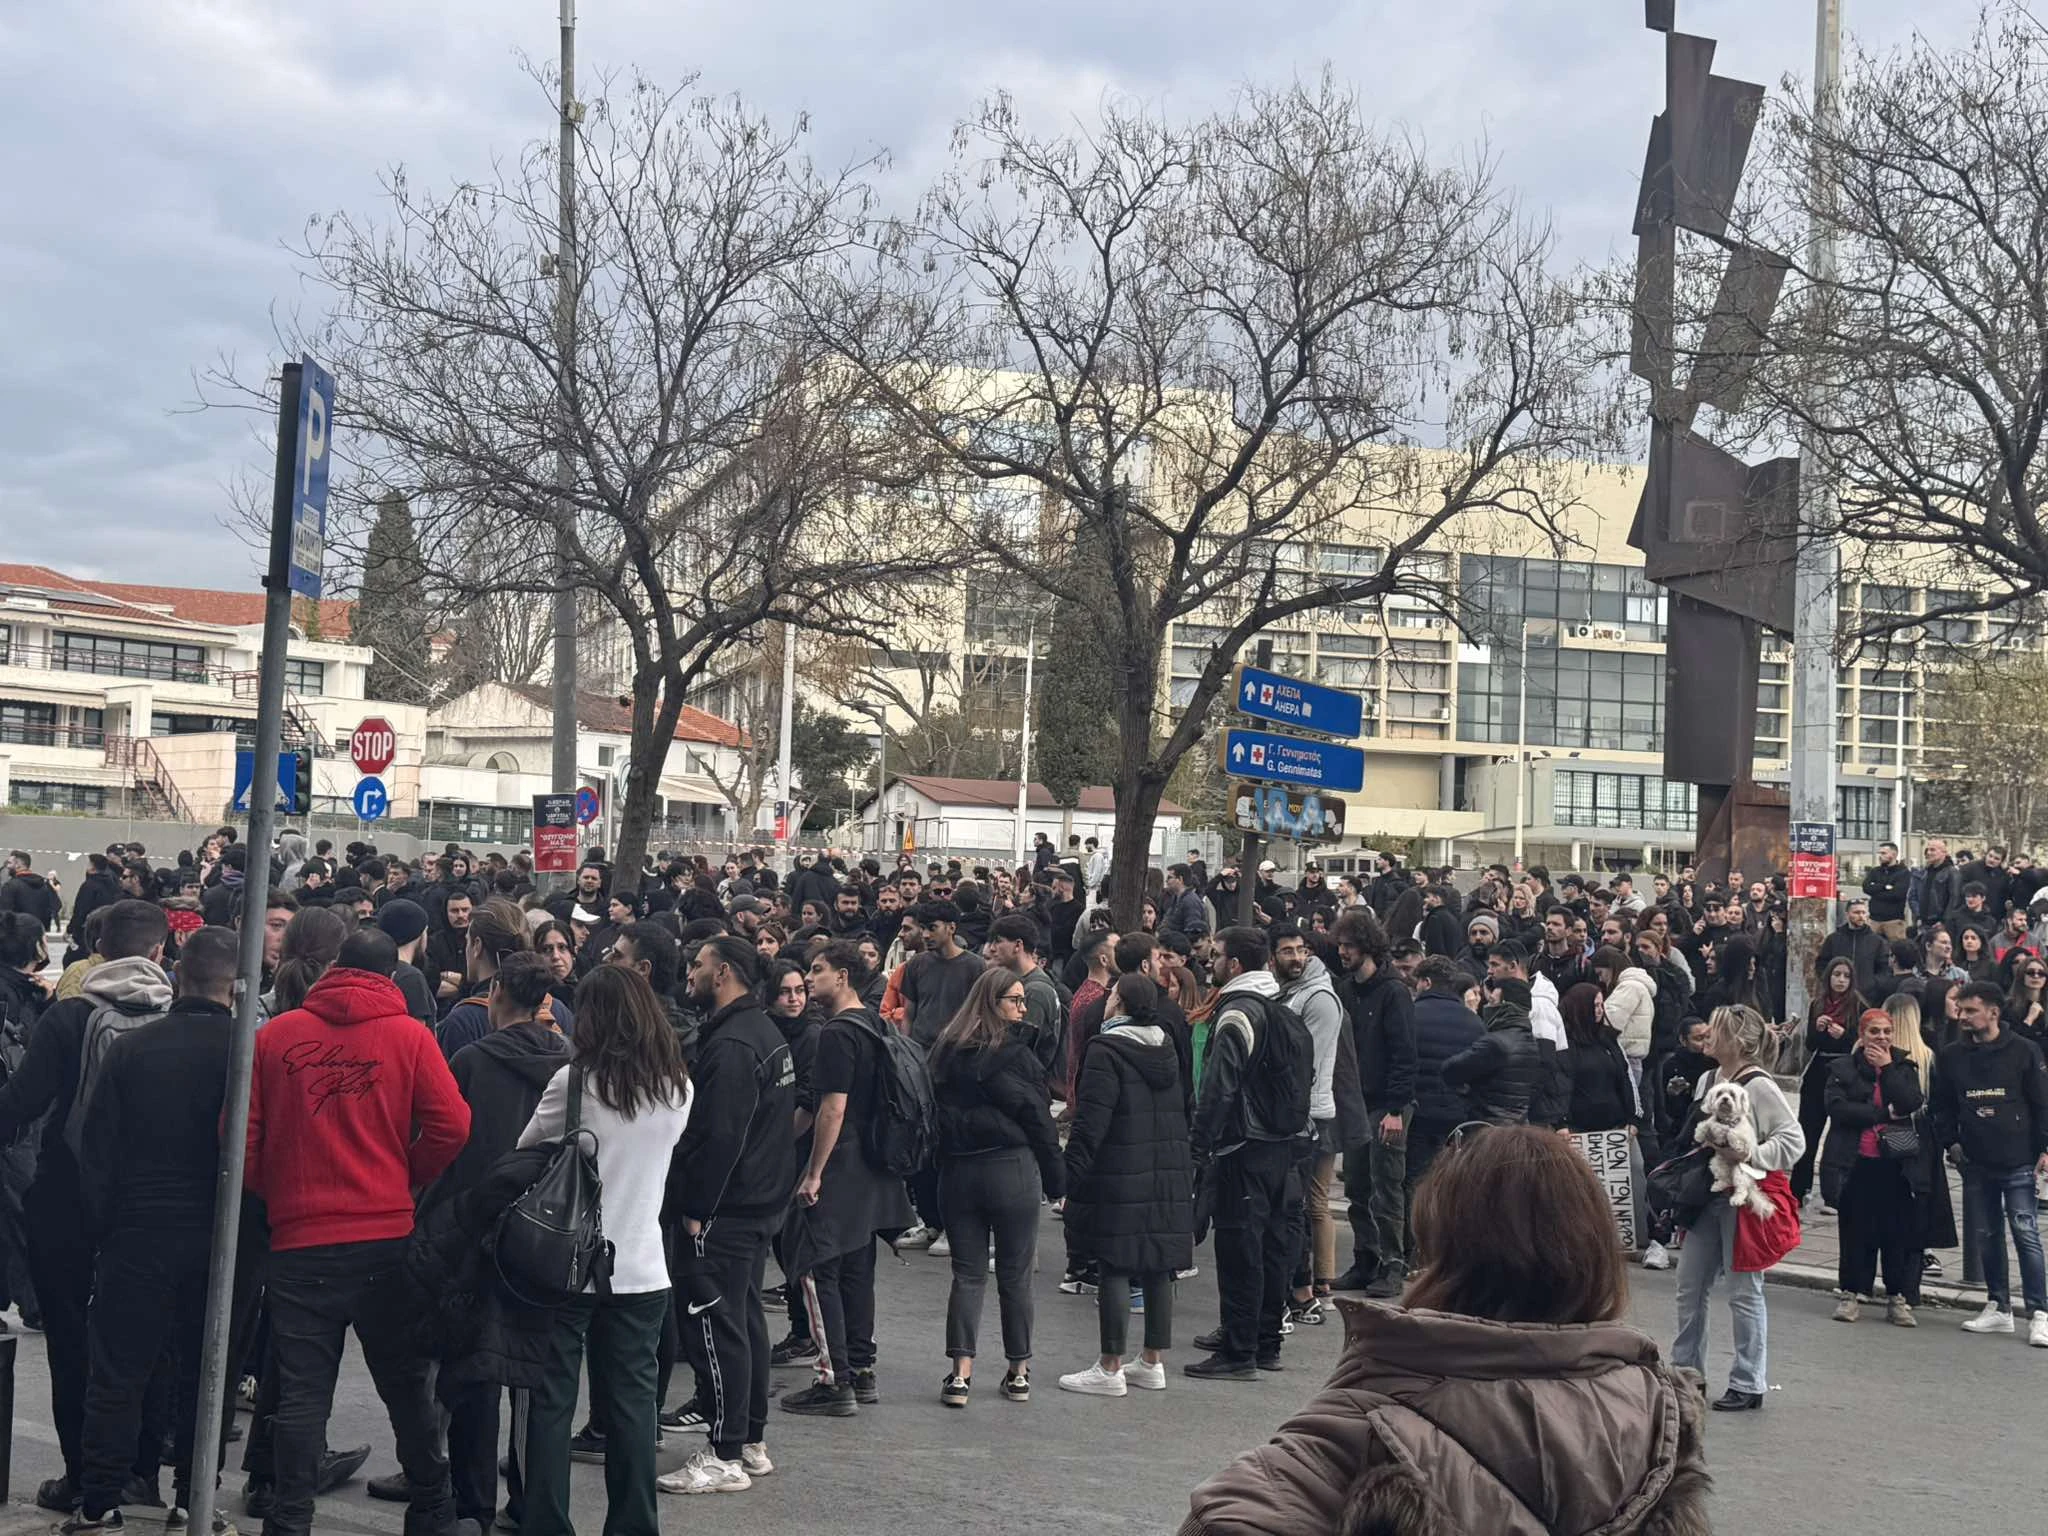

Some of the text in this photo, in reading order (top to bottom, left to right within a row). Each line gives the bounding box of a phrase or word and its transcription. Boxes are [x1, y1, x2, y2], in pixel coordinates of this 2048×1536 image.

[303, 387, 326, 496] P
[1276, 684, 1301, 700] ΑΧΕΠΑ
[1274, 699, 1301, 717] AHEPA
[353, 731, 393, 761] STOP
[1267, 760, 1323, 779] G. Gennimatas
